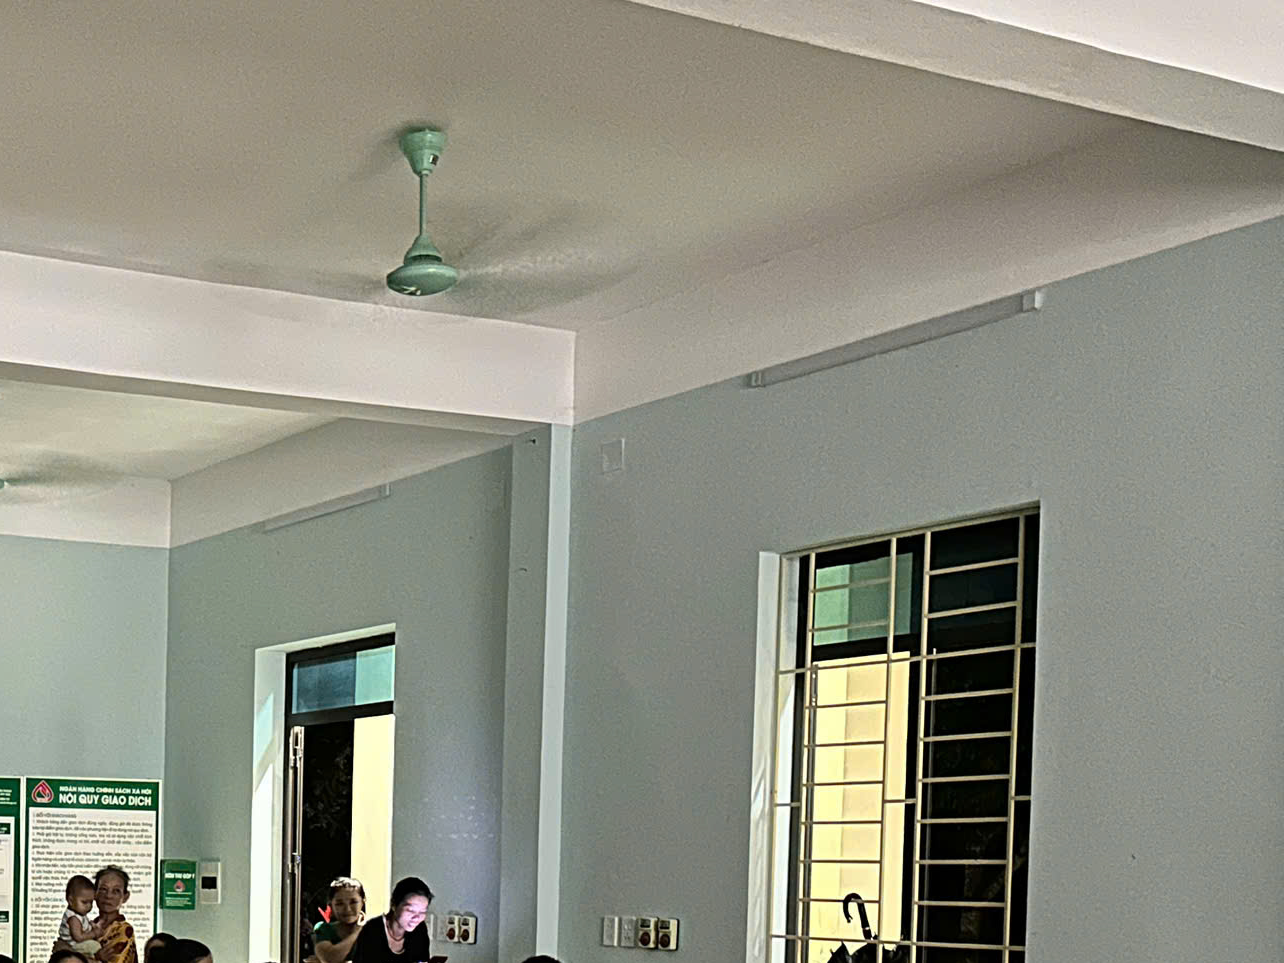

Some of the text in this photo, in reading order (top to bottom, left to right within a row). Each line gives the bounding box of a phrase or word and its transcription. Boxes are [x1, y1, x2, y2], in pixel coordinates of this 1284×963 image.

[59, 793, 152, 806] NỘI QUY GIAO DỊCH
